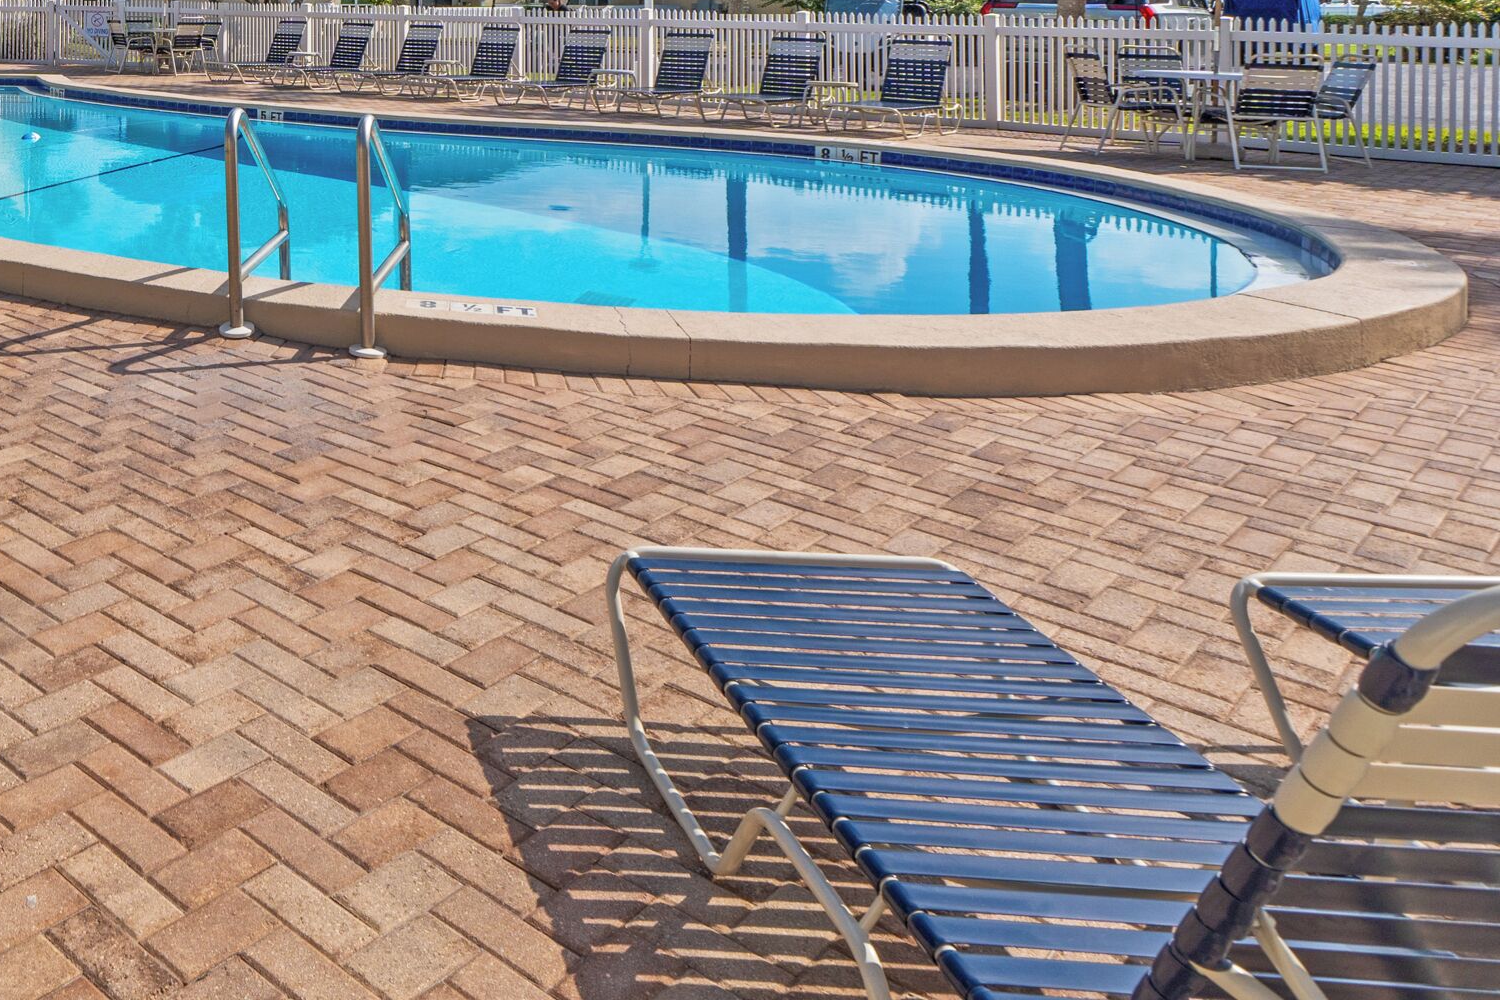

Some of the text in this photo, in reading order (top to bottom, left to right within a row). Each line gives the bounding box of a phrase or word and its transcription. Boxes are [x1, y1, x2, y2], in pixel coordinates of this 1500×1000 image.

[270, 111, 282, 121] FT
[821, 147, 830, 158] 8
[860, 150, 879, 163] FT
[420, 300, 437, 308] 8
